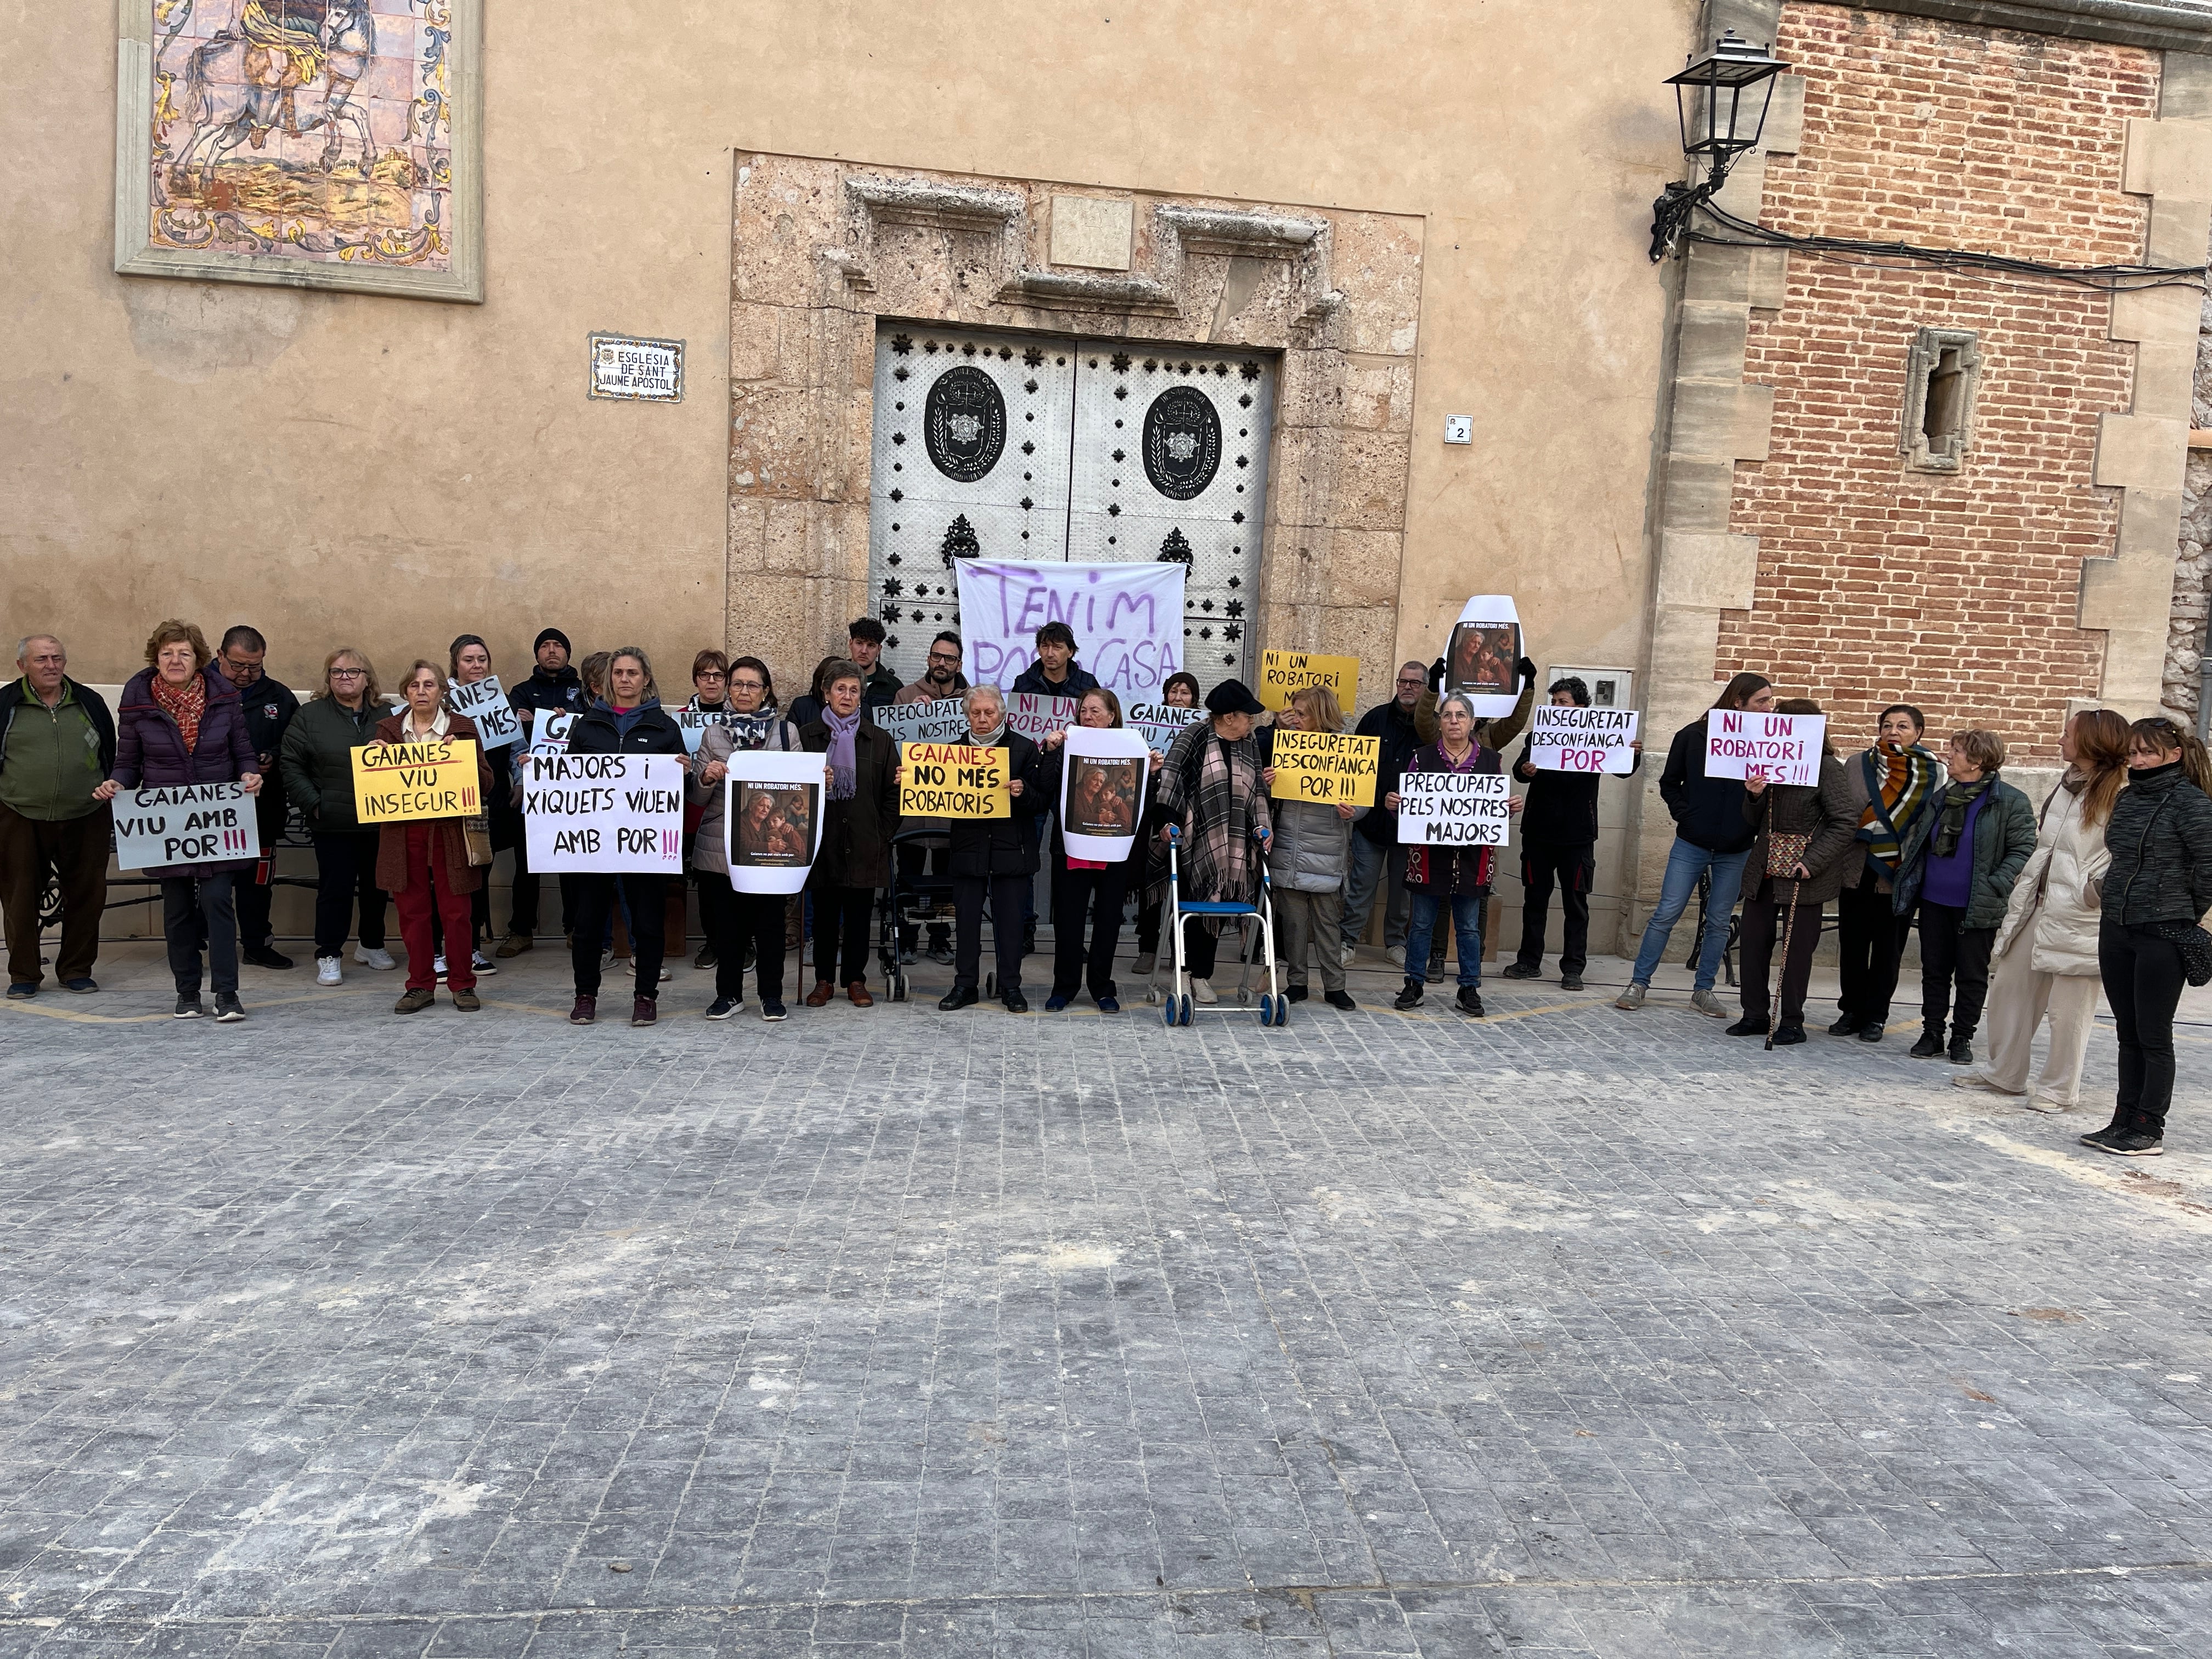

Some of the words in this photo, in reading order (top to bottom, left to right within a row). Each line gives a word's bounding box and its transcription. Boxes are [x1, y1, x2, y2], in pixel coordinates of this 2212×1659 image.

[600, 374, 630, 387] JAUME
[622, 364, 634, 375] DE
[638, 365, 665, 377] SANT
[1457, 428, 1464, 438] 2
[1092, 638, 1177, 690] CASA
[1289, 655, 1308, 669] UN
[1019, 693, 1039, 714] NI
[1052, 696, 1079, 718] UN
[482, 706, 517, 739] MÉS
[1764, 716, 1793, 737] UN
[909, 743, 997, 765] GAIANES
[1560, 748, 1604, 773] POR
[534, 755, 626, 781] MAJORS
[915, 765, 946, 786] NO
[958, 766, 1000, 788] MÉS
[1404, 773, 1505, 794] PREOCUPATS
[1401, 797, 1434, 816] PELS
[1440, 798, 1508, 818] NOSTRES
[116, 816, 166, 838] VIU
[184, 808, 238, 831] AMB
[1426, 822, 1502, 844] MAJORS
[554, 828, 601, 856] AMB
